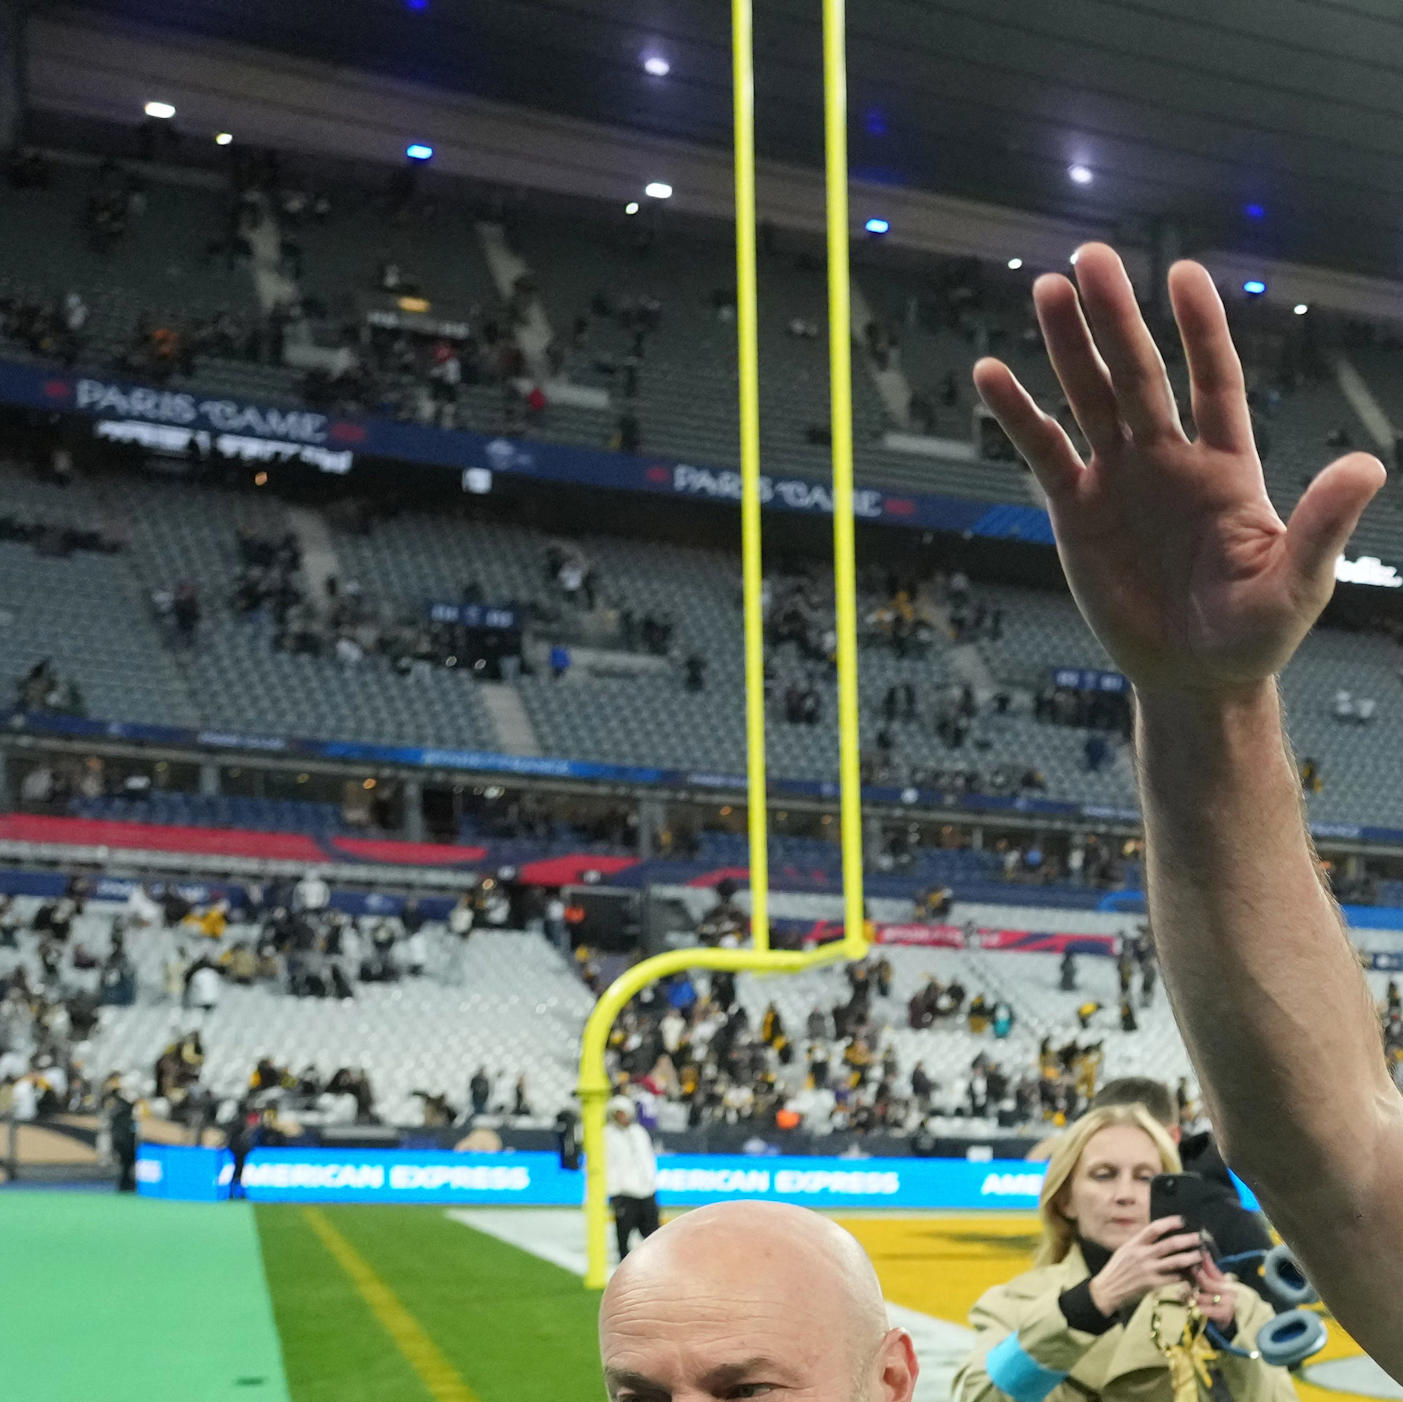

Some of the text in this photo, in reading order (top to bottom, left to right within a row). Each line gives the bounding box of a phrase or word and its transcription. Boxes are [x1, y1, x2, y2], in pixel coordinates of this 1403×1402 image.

[76, 378, 328, 443] PARIS GAME
[673, 463, 882, 517] PARS GAE
[214, 1163, 531, 1190] AMERICAN EXPRESS
[774, 1171, 899, 1195] EXPRESS
